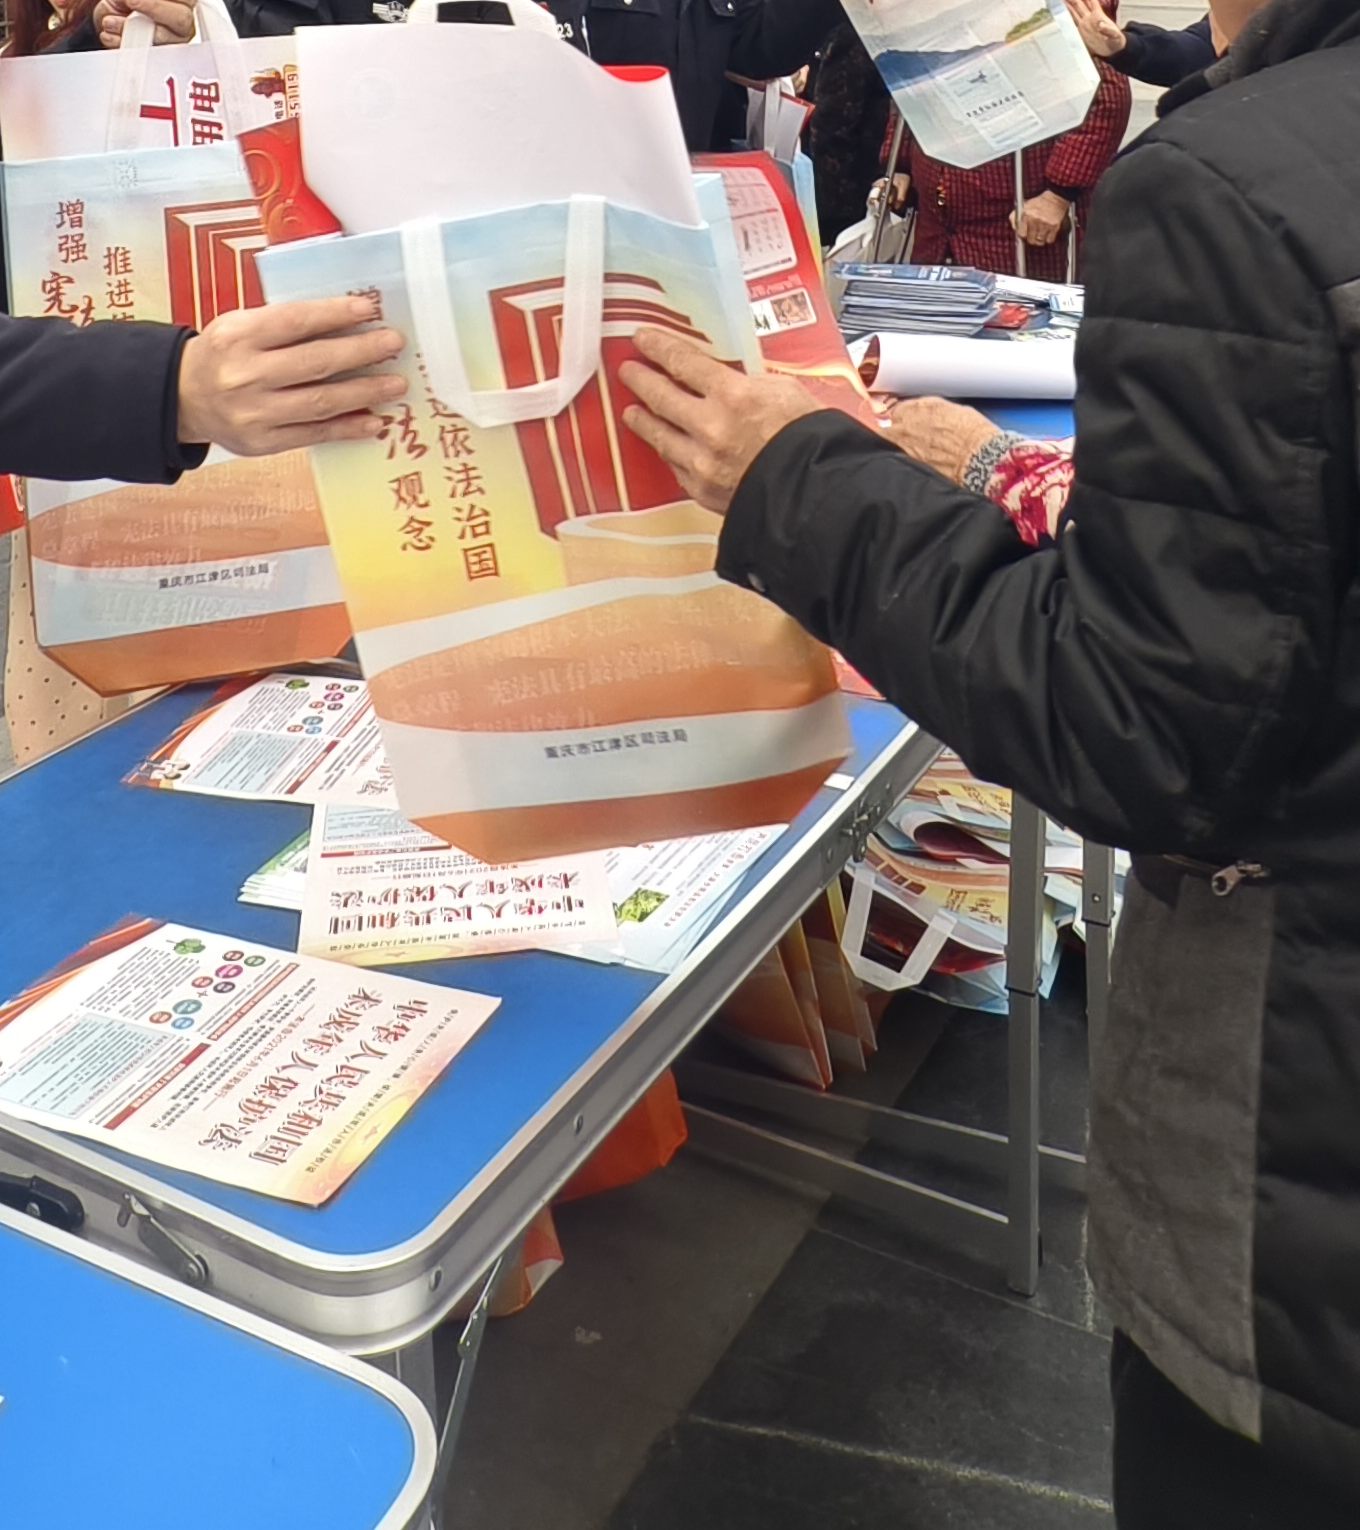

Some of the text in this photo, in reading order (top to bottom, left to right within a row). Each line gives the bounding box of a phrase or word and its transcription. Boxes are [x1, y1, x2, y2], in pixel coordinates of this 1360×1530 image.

[197, 986, 384, 1151] 未成年人保护法
[248, 998, 430, 1167] 中华人民共和国
